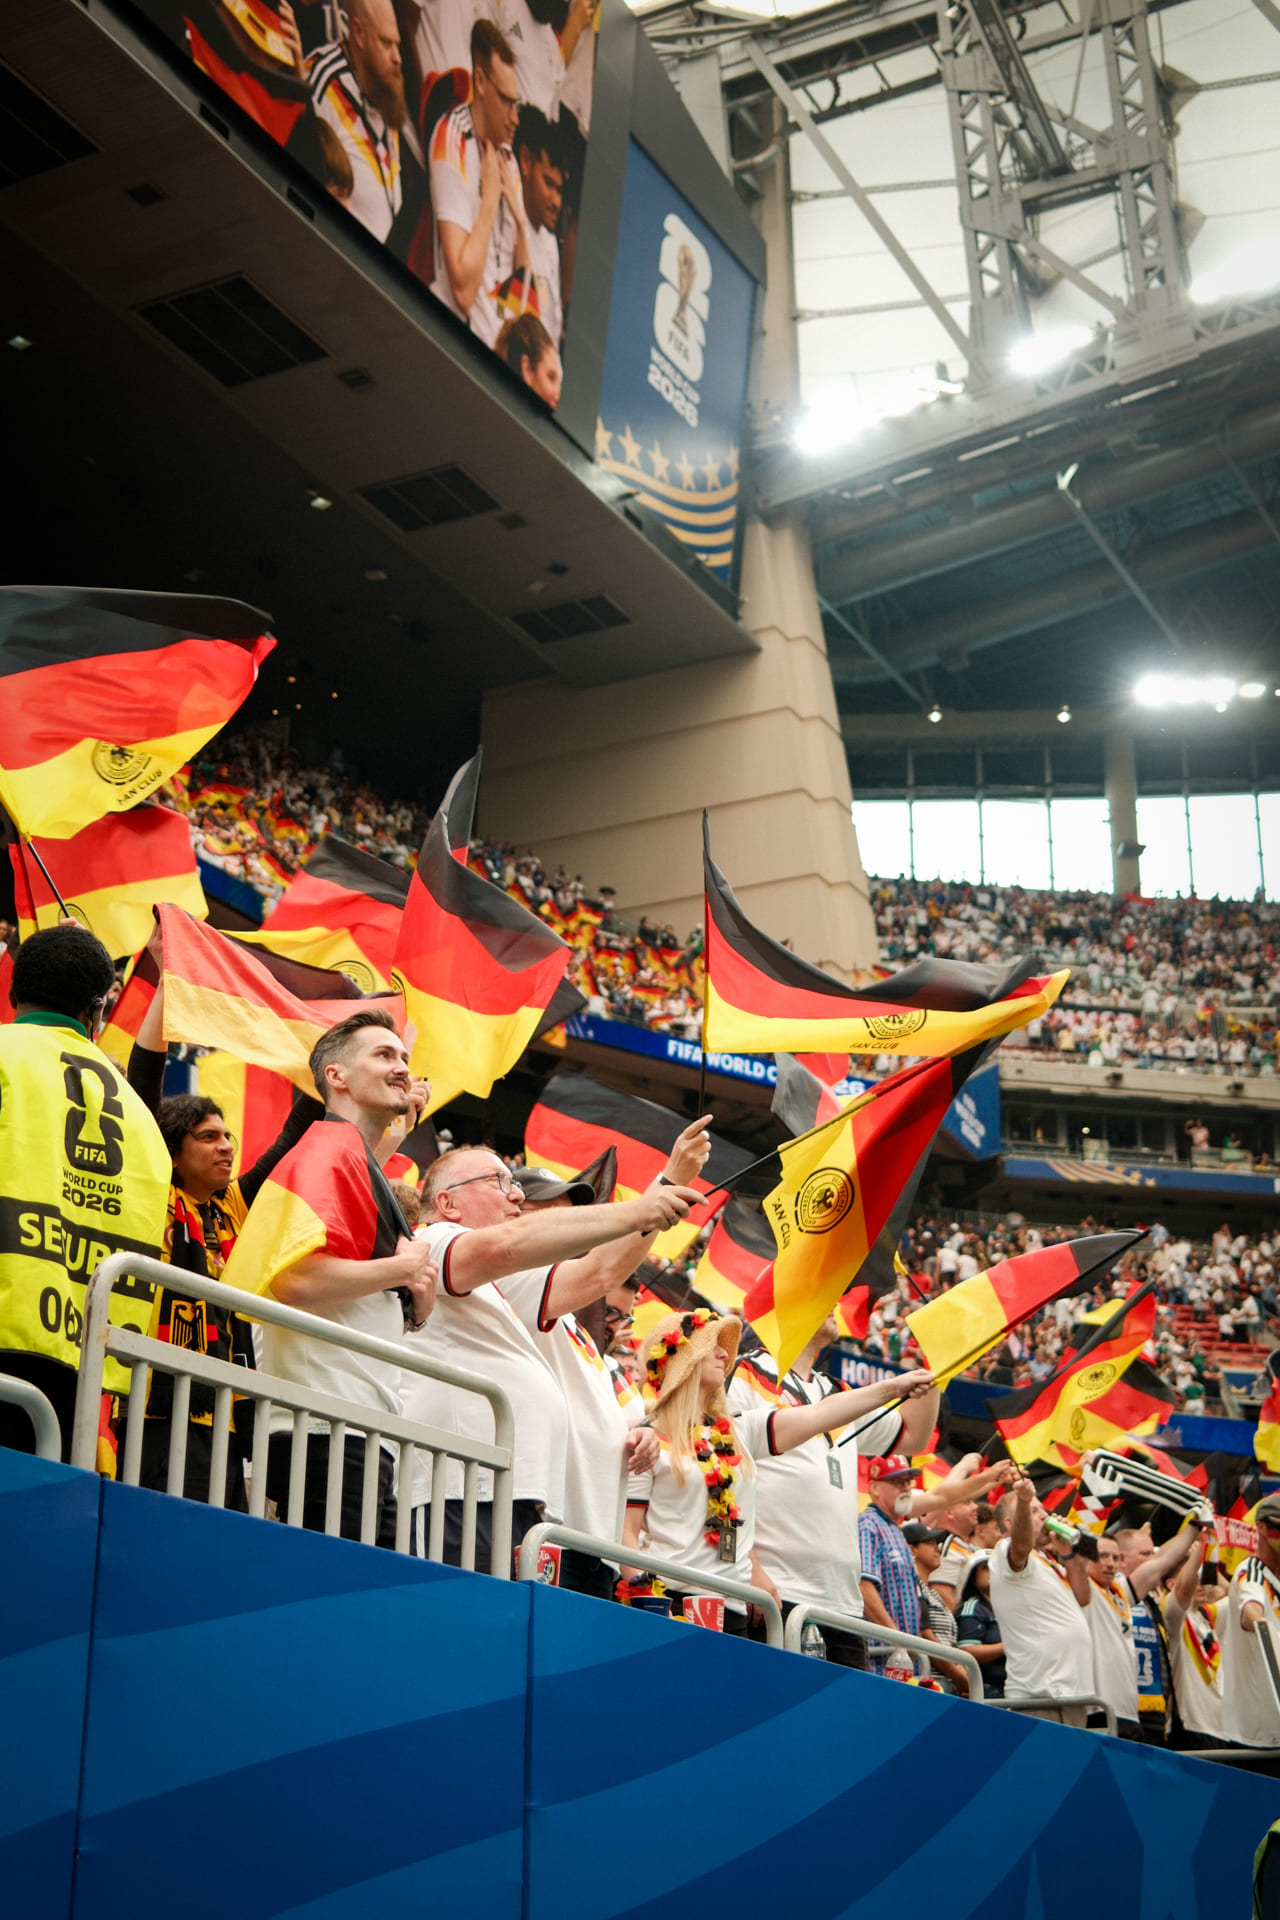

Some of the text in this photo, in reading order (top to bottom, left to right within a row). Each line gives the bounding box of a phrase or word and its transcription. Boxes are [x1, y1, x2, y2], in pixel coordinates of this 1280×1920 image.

[647, 363, 698, 429] 2026
[667, 1039, 702, 1064] FIFA
[705, 1052, 766, 1081] WORLD
[871, 1042, 899, 1050] CLUB
[74, 1144, 108, 1165] FIFA
[62, 1167, 124, 1196] WORLD CUP
[62, 1181, 122, 1216] 2026
[771, 1195, 787, 1221] AN
